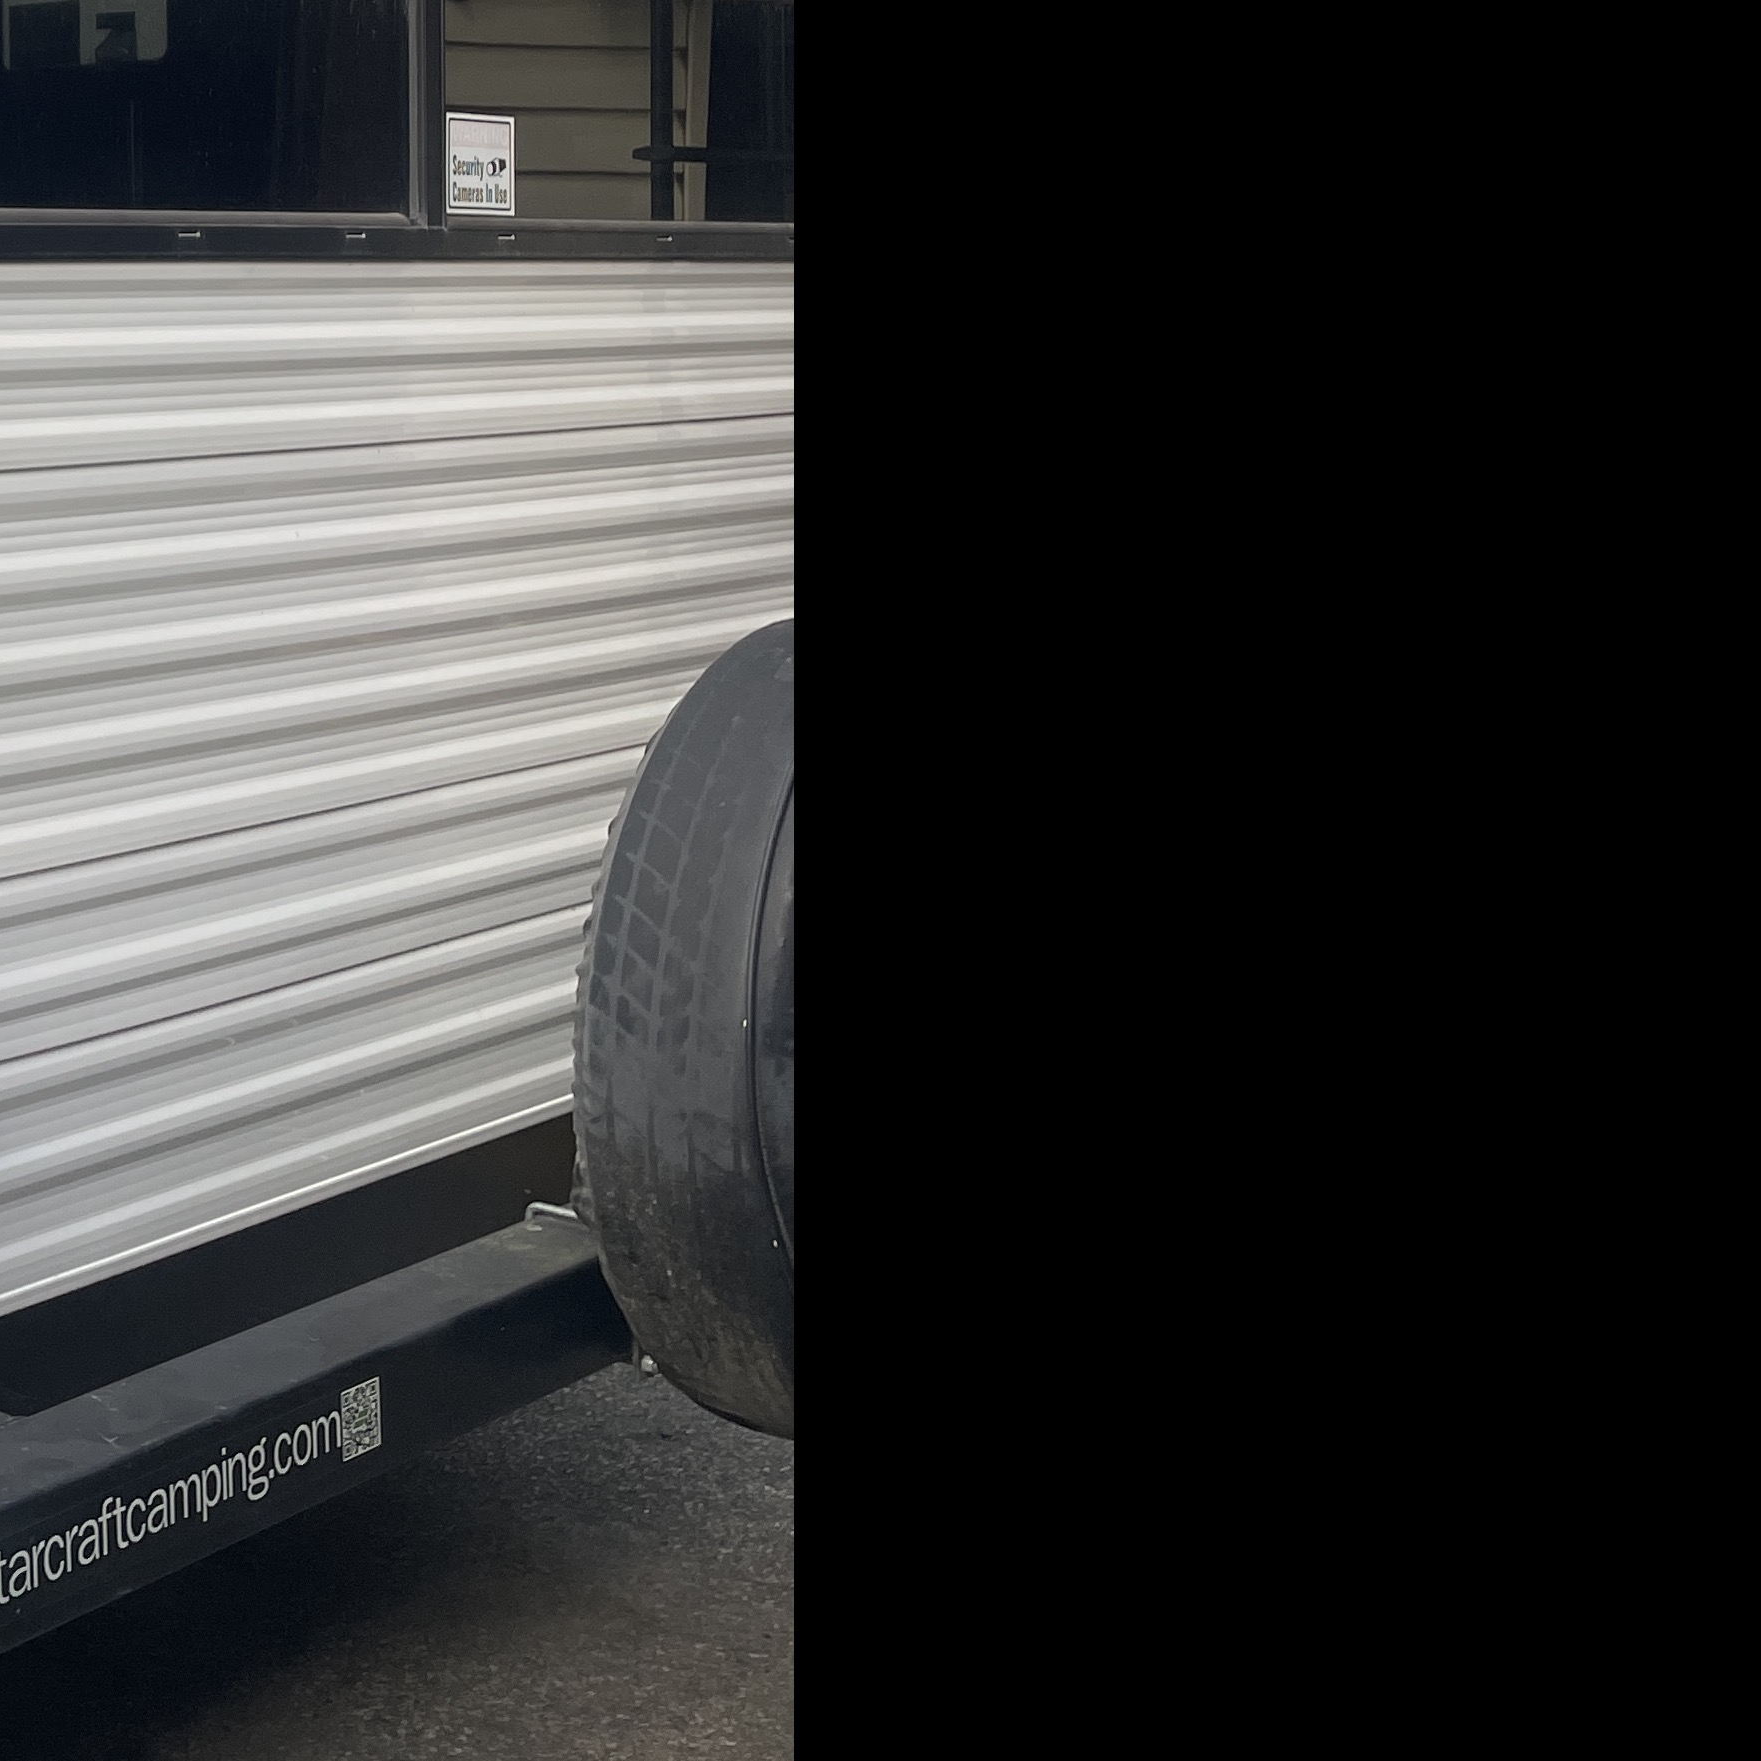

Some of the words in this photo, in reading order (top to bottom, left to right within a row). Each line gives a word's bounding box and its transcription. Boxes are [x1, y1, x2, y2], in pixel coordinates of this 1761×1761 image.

[452, 154, 485, 181] Security
[452, 181, 484, 203] Cameras
[485, 183, 493, 203] In
[495, 184, 508, 204] Use
